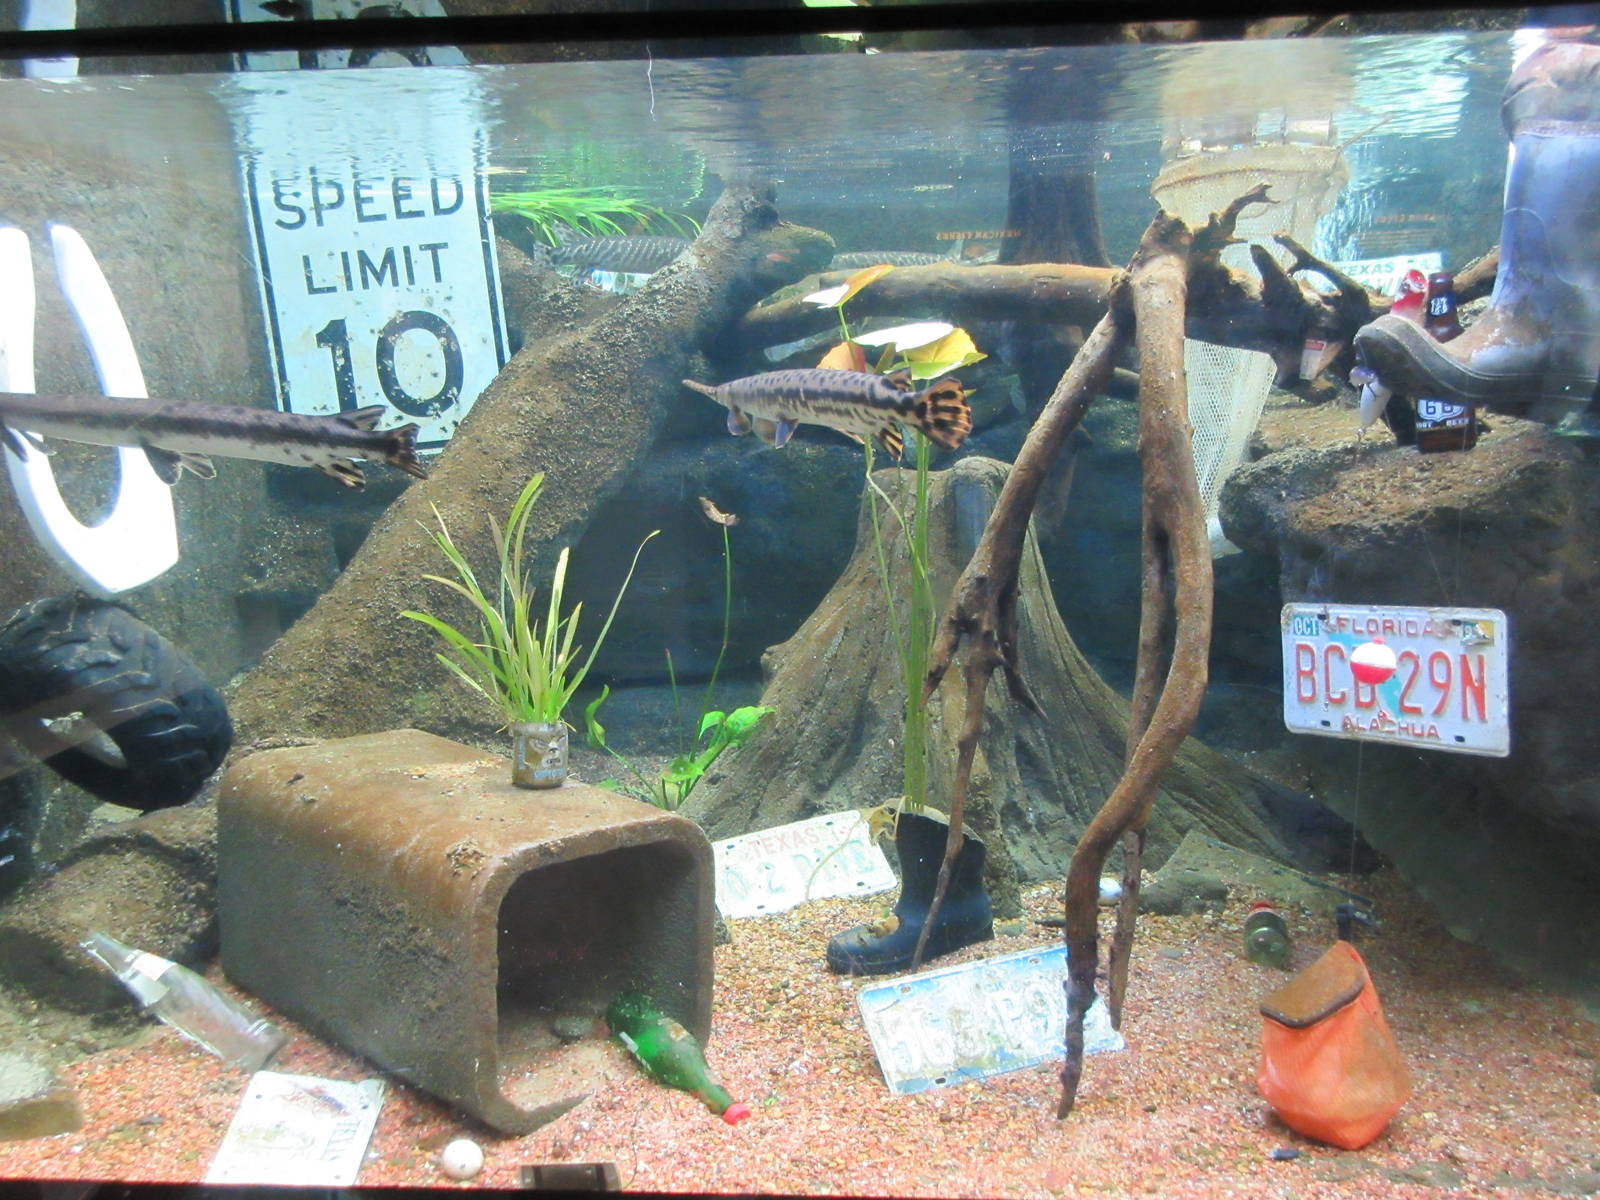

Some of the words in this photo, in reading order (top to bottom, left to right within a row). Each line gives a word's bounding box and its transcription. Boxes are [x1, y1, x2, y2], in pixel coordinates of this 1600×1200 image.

[272, 175, 464, 231] SPEED
[302, 243, 449, 295] LIMIT
[316, 310, 464, 418] 10
[1294, 616, 1318, 635] OCT
[1399, 650, 1488, 722] 29N
[749, 826, 821, 860] TEXAS
